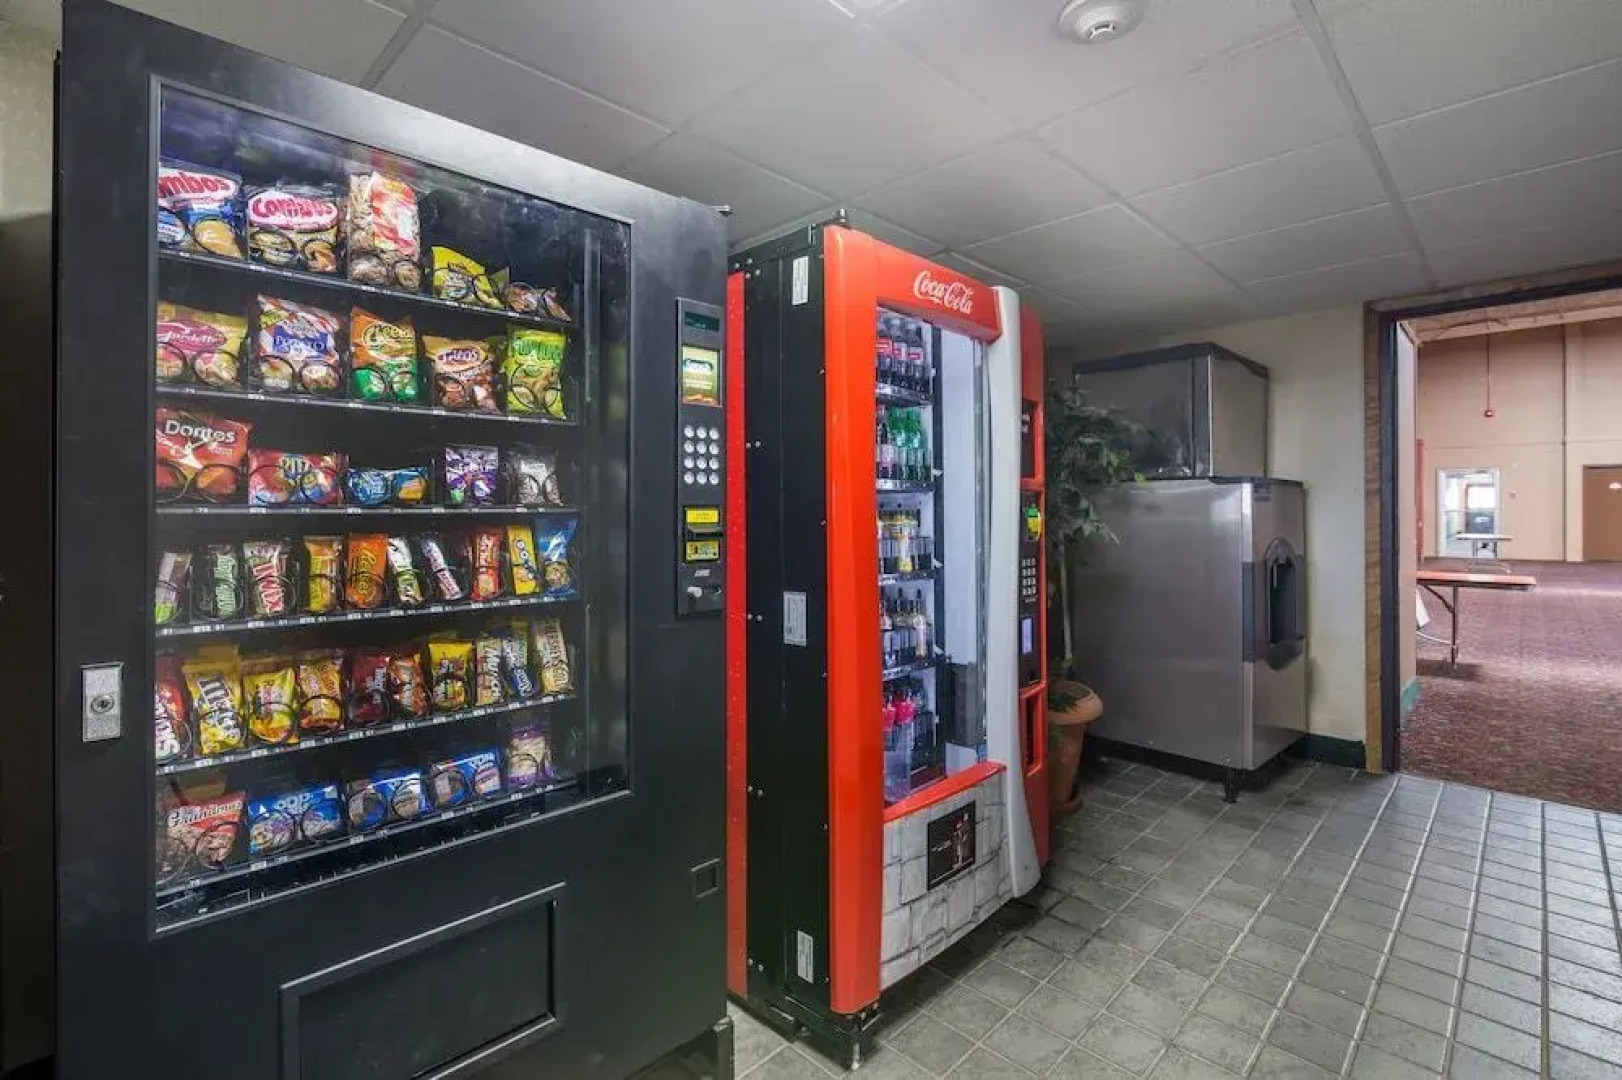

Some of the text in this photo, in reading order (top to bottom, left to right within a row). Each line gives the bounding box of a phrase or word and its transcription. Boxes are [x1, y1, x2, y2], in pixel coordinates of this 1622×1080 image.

[158, 172, 230, 196] mbos
[252, 197, 334, 218] Combos
[164, 418, 236, 445] Doritos
